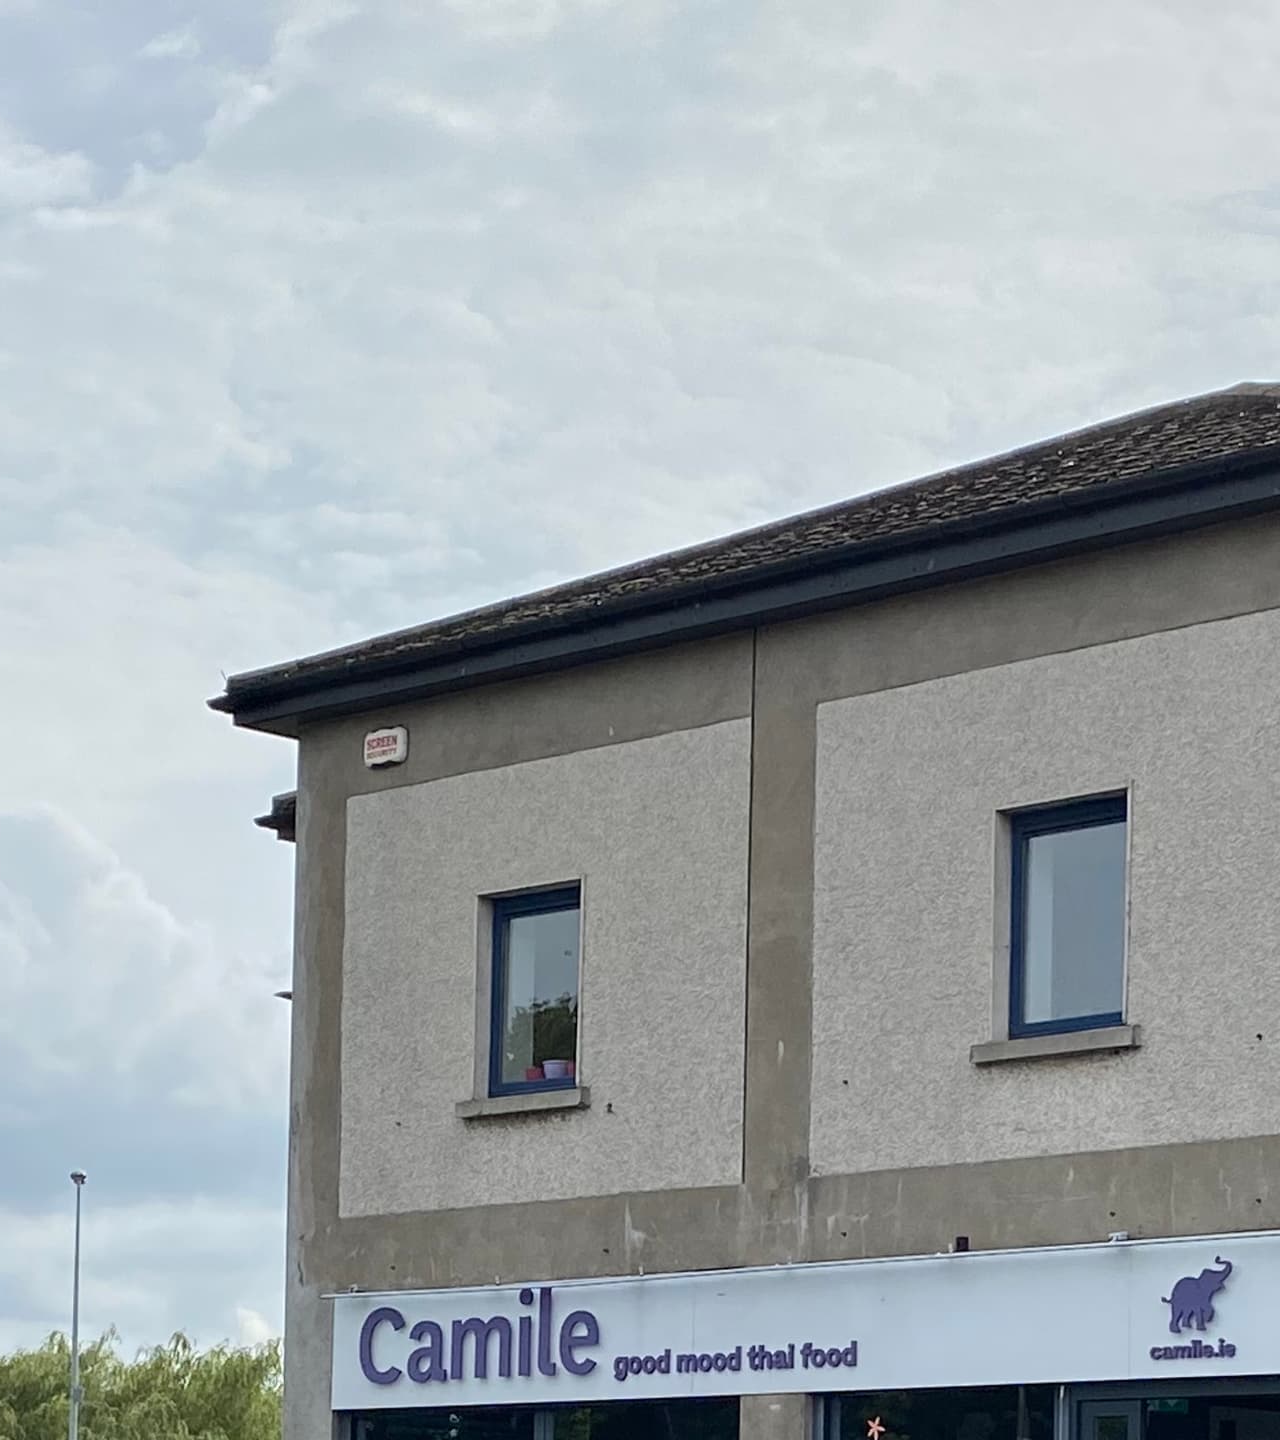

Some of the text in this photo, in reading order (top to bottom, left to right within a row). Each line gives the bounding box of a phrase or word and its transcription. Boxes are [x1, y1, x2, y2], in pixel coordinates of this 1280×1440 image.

[360, 1287, 858, 1385] Camile good mood thai food
[1150, 1338, 1237, 1361] camile.ie
